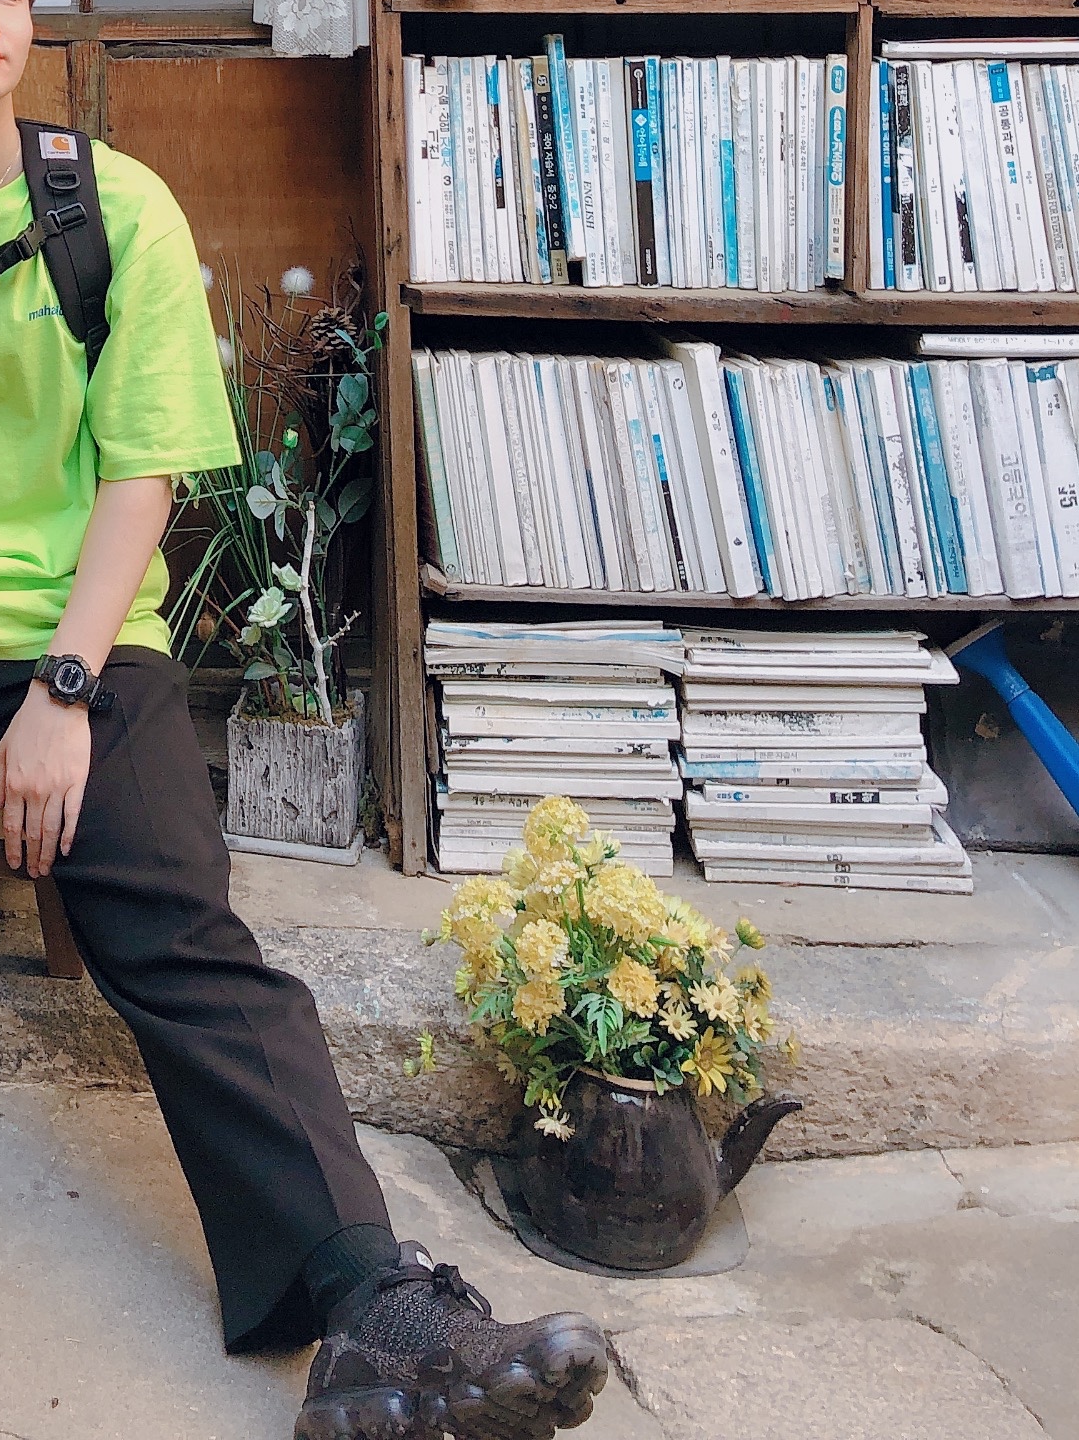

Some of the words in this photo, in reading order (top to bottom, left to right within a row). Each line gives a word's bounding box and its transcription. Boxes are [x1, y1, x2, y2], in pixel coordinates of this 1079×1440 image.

[542, 133, 552, 150] 국어
[543, 152, 555, 177] 자습서
[443, 176, 451, 186] 3
[1044, 171, 1054, 204] ENGLISH
[547, 183, 558, 210] 중3-2
[583, 180, 595, 230] ENGLISH
[1049, 205, 1057, 218] FOR
[1052, 218, 1064, 251] EVERYONE
